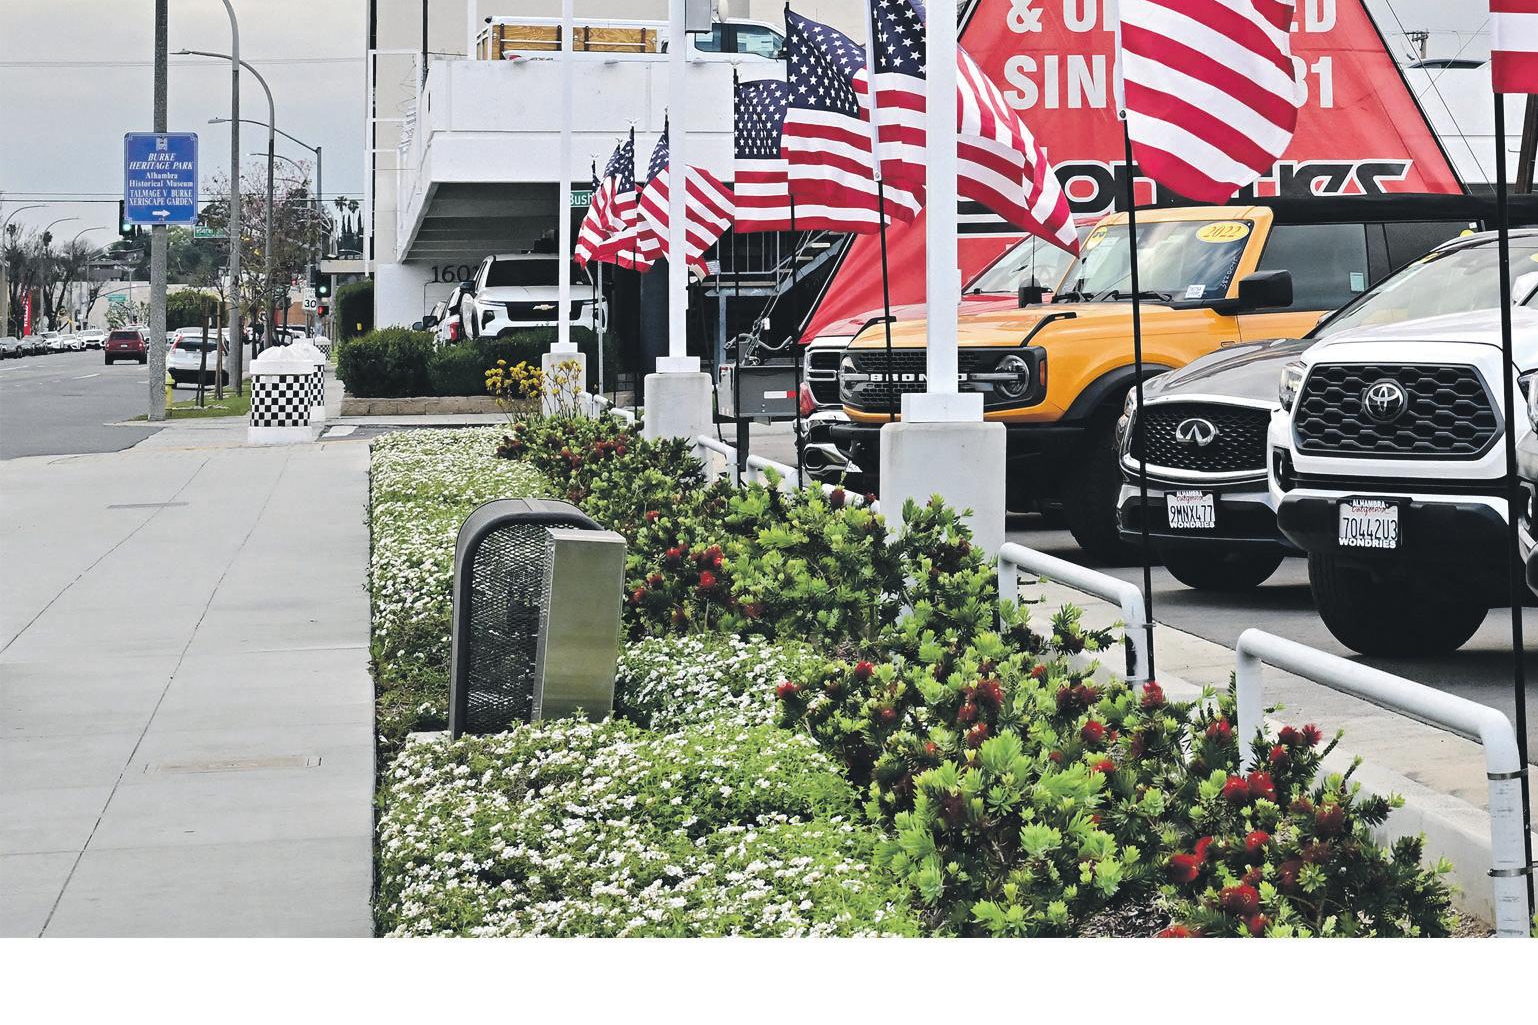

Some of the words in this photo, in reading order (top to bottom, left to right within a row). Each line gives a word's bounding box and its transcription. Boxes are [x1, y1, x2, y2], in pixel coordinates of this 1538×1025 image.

[148, 153, 176, 161] BURKE
[129, 162, 170, 170] HERITAGE
[173, 162, 193, 170] PARK
[1204, 227, 1242, 238] 2022
[305, 299, 316, 308] 30
[871, 373, 967, 381] BRONO
[1353, 499, 1386, 508] ALHAMBRA
[1170, 505, 1213, 523] 9MNX477
[1343, 518, 1398, 540] 70442U3
[1339, 538, 1396, 549] WONDRIES
